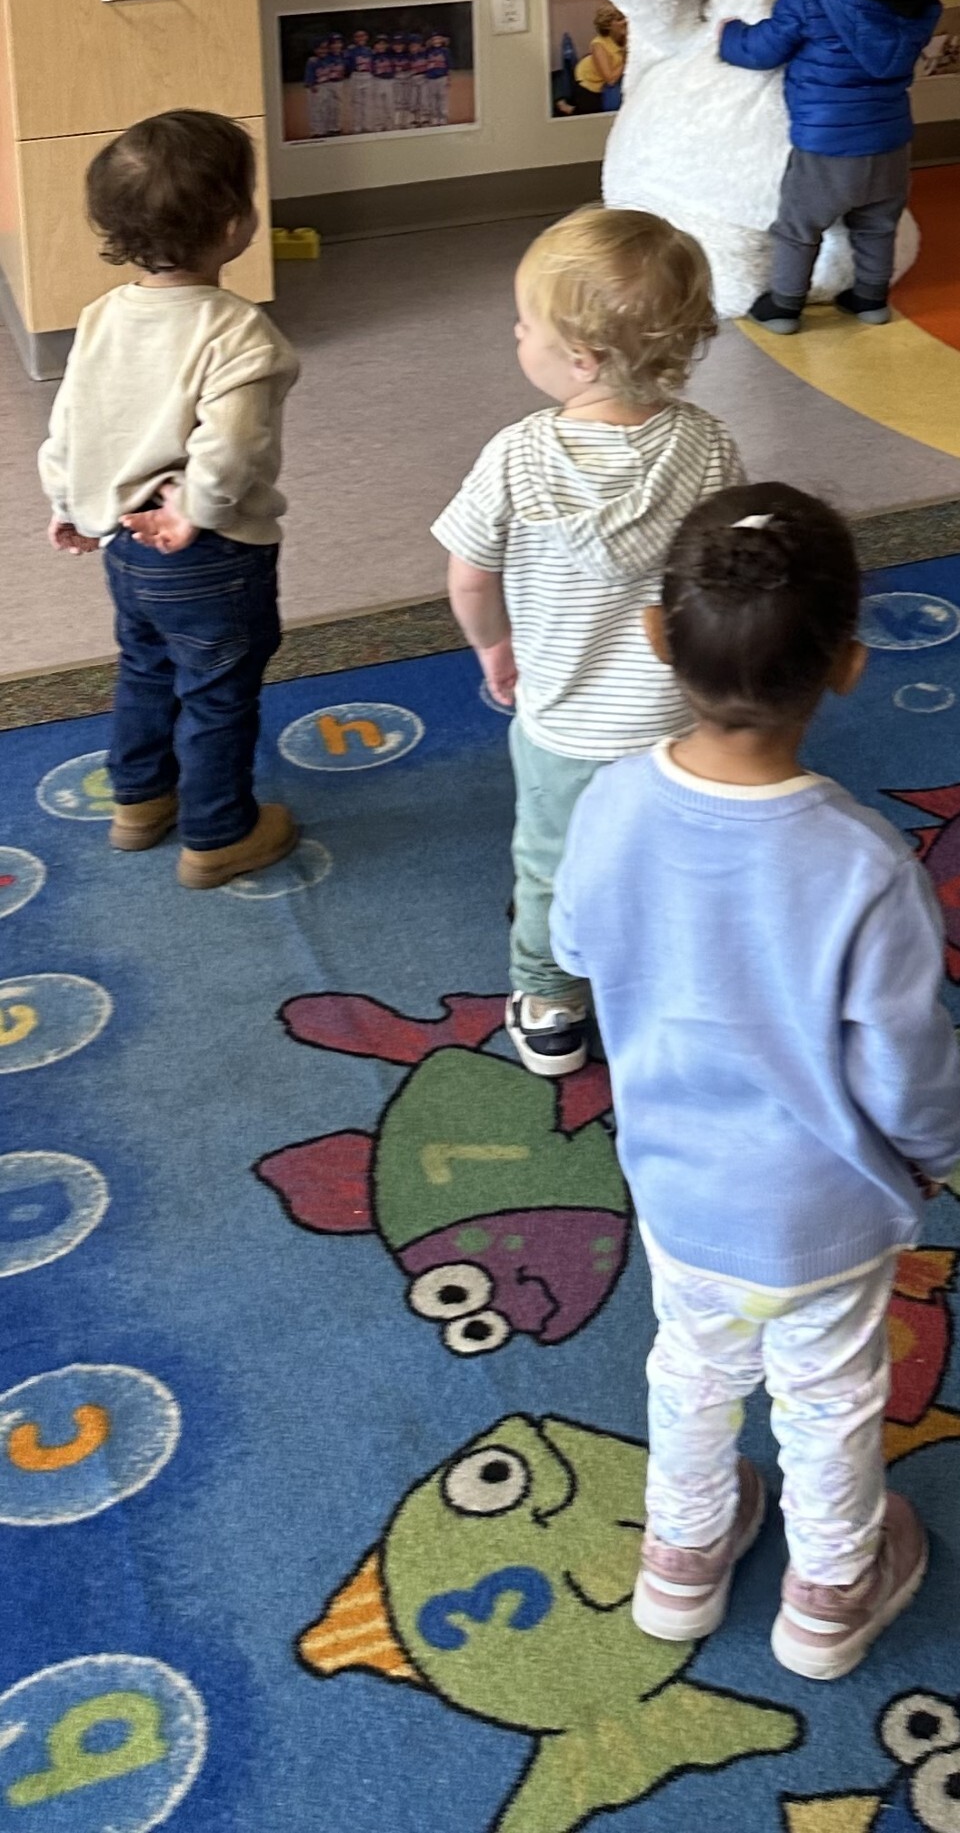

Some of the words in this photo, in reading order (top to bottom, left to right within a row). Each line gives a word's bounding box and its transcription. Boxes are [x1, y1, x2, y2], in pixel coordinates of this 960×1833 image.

[316, 713, 384, 756] h
[420, 1143, 531, 1186] 1
[8, 1403, 111, 1471] c
[416, 1564, 555, 1652] 3
